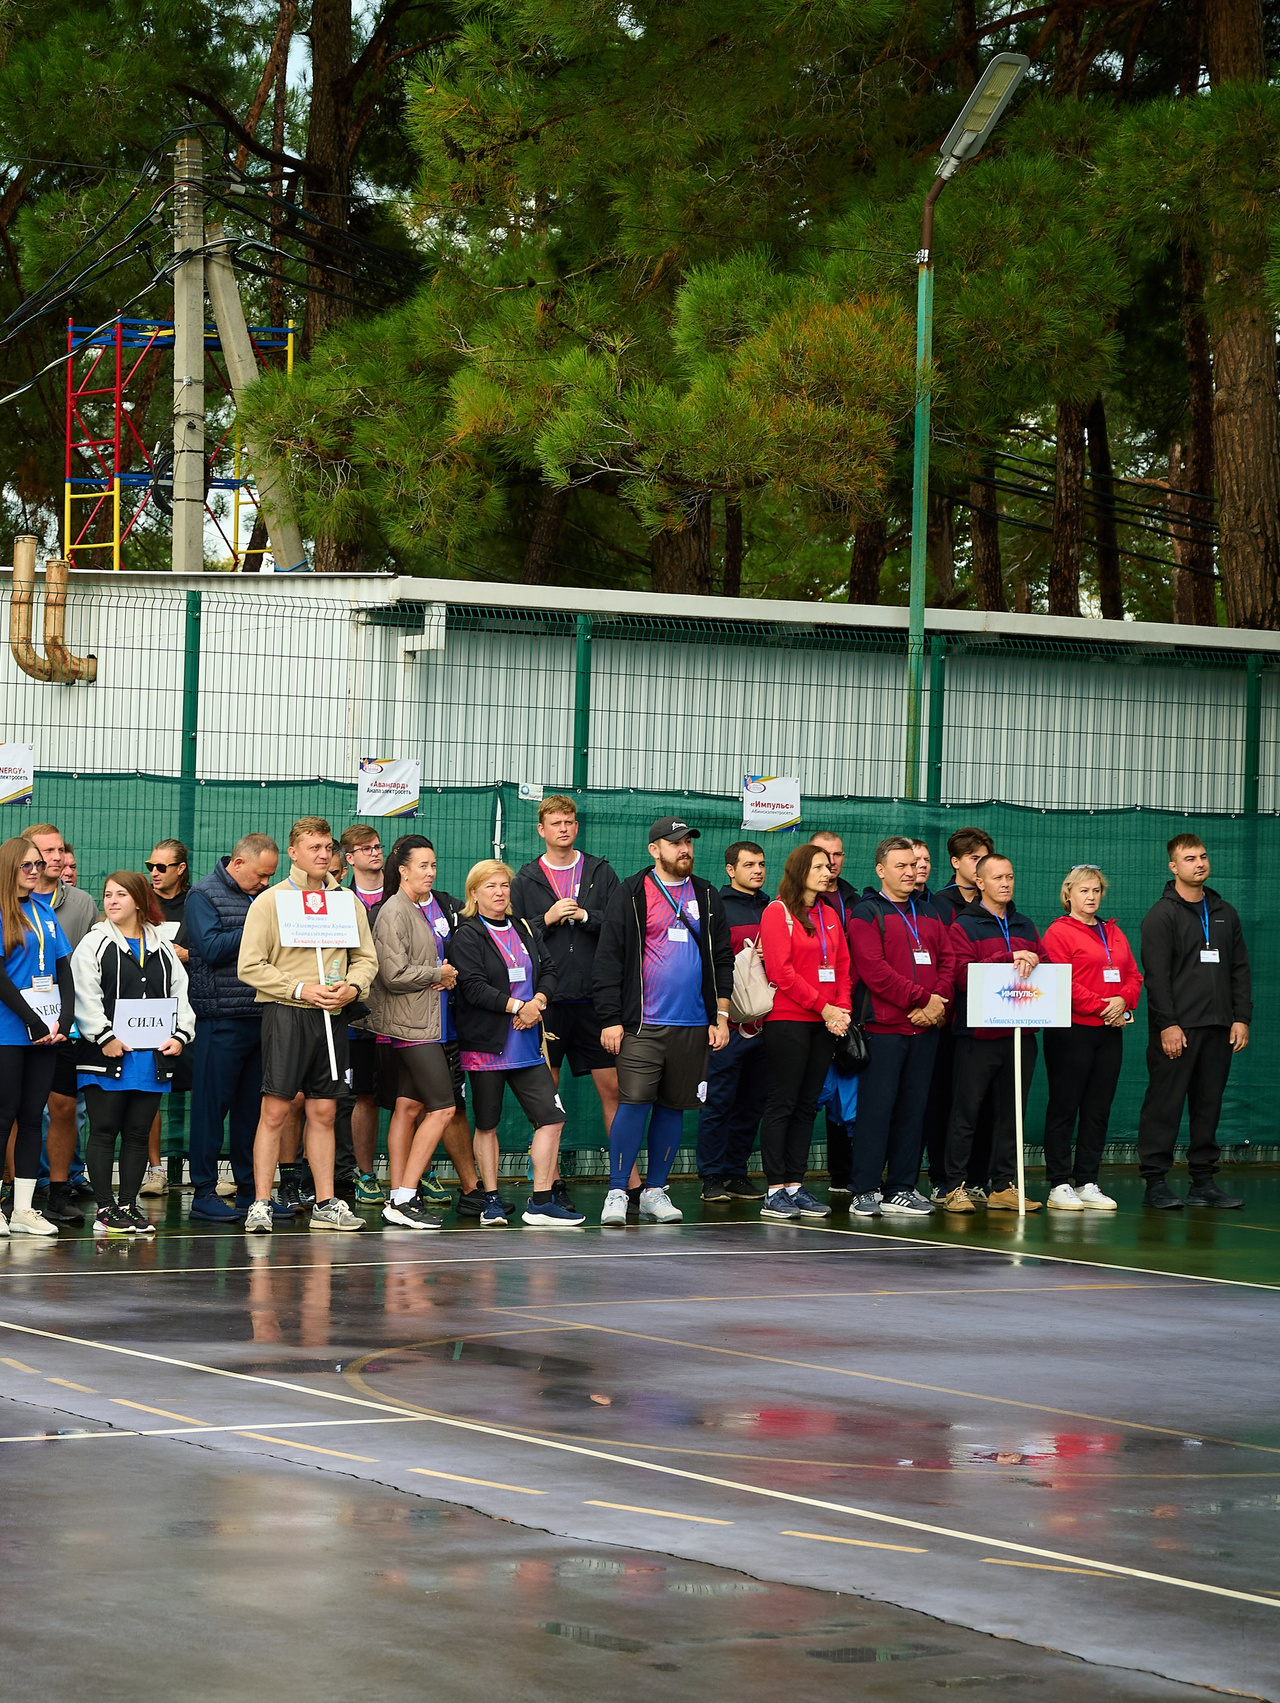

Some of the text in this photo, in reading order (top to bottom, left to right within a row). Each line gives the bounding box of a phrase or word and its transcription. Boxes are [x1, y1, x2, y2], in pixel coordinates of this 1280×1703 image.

[750, 800, 794, 810] «Импульс»
[31, 1003, 61, 1017] NERG
[127, 1016, 164, 1028] СИЛА
